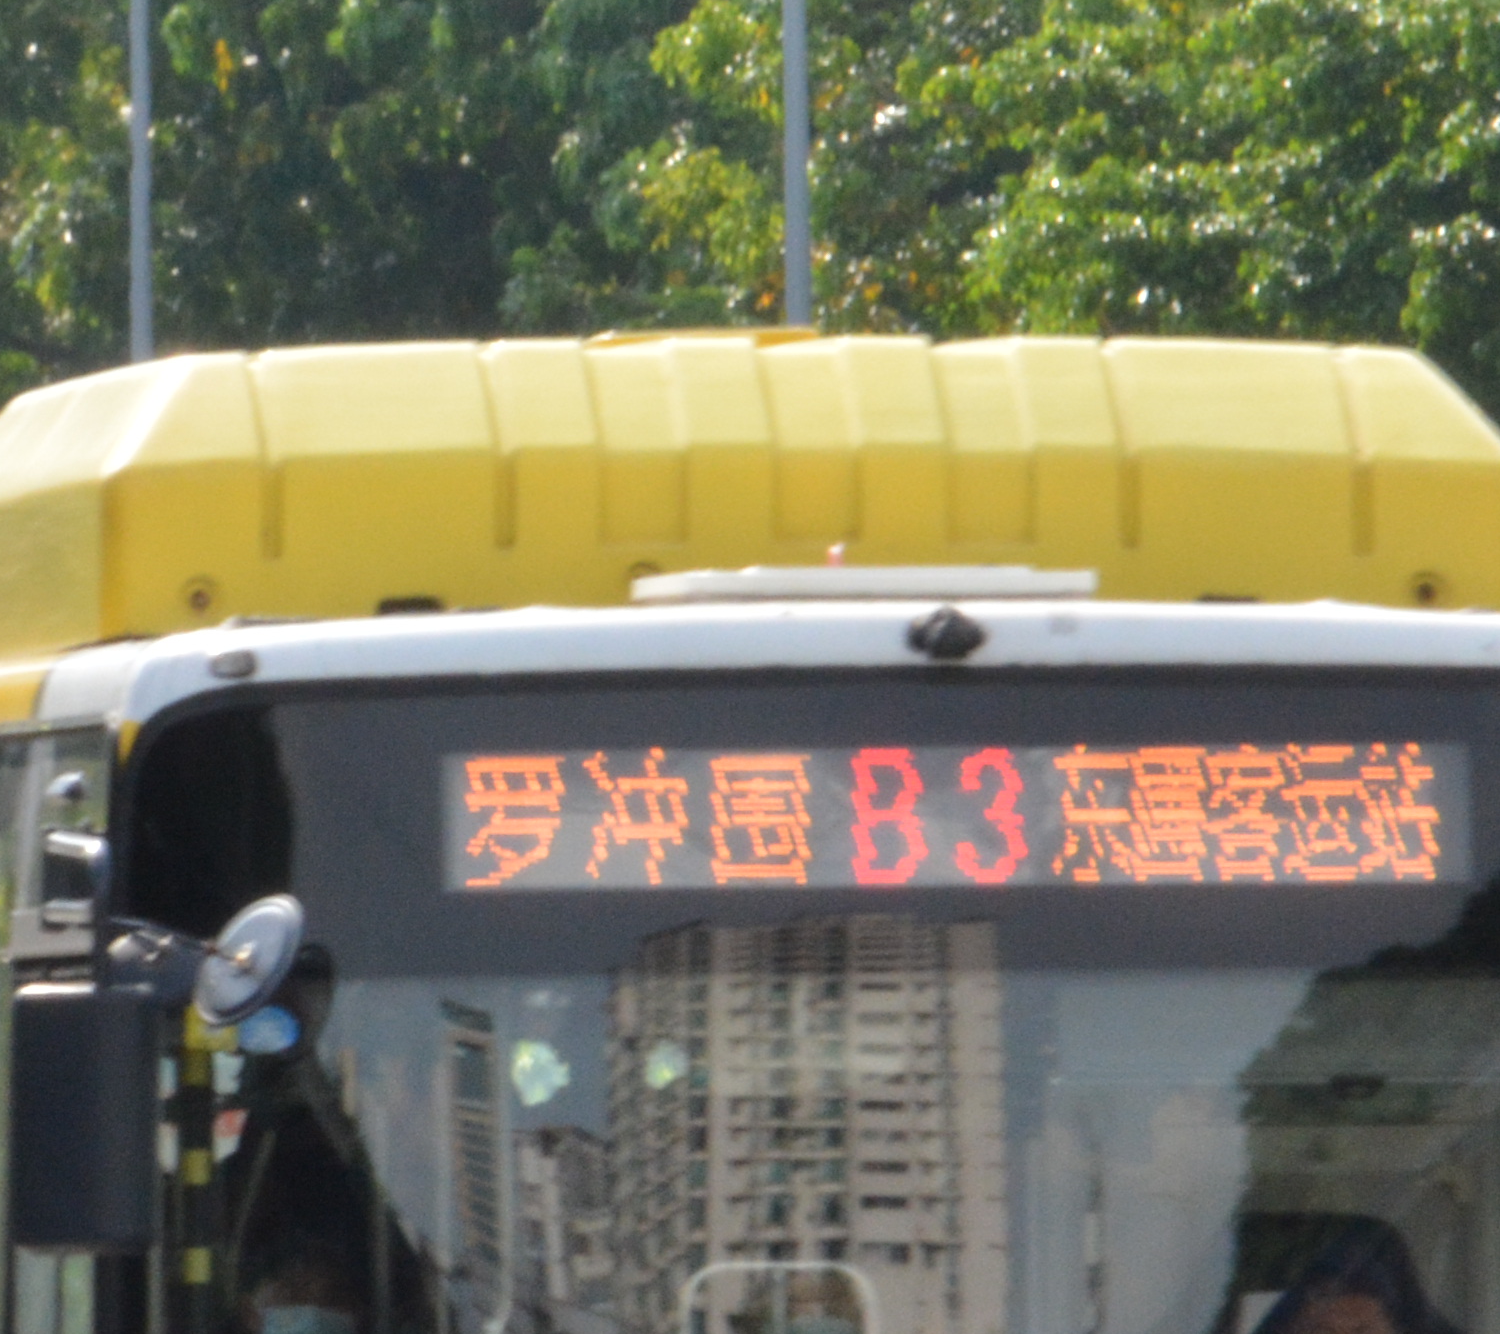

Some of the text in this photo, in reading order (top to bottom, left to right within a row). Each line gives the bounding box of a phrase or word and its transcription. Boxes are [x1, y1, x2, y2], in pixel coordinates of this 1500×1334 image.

[463, 746, 812, 888] 罗冲围
[850, 746, 1028, 885] B3
